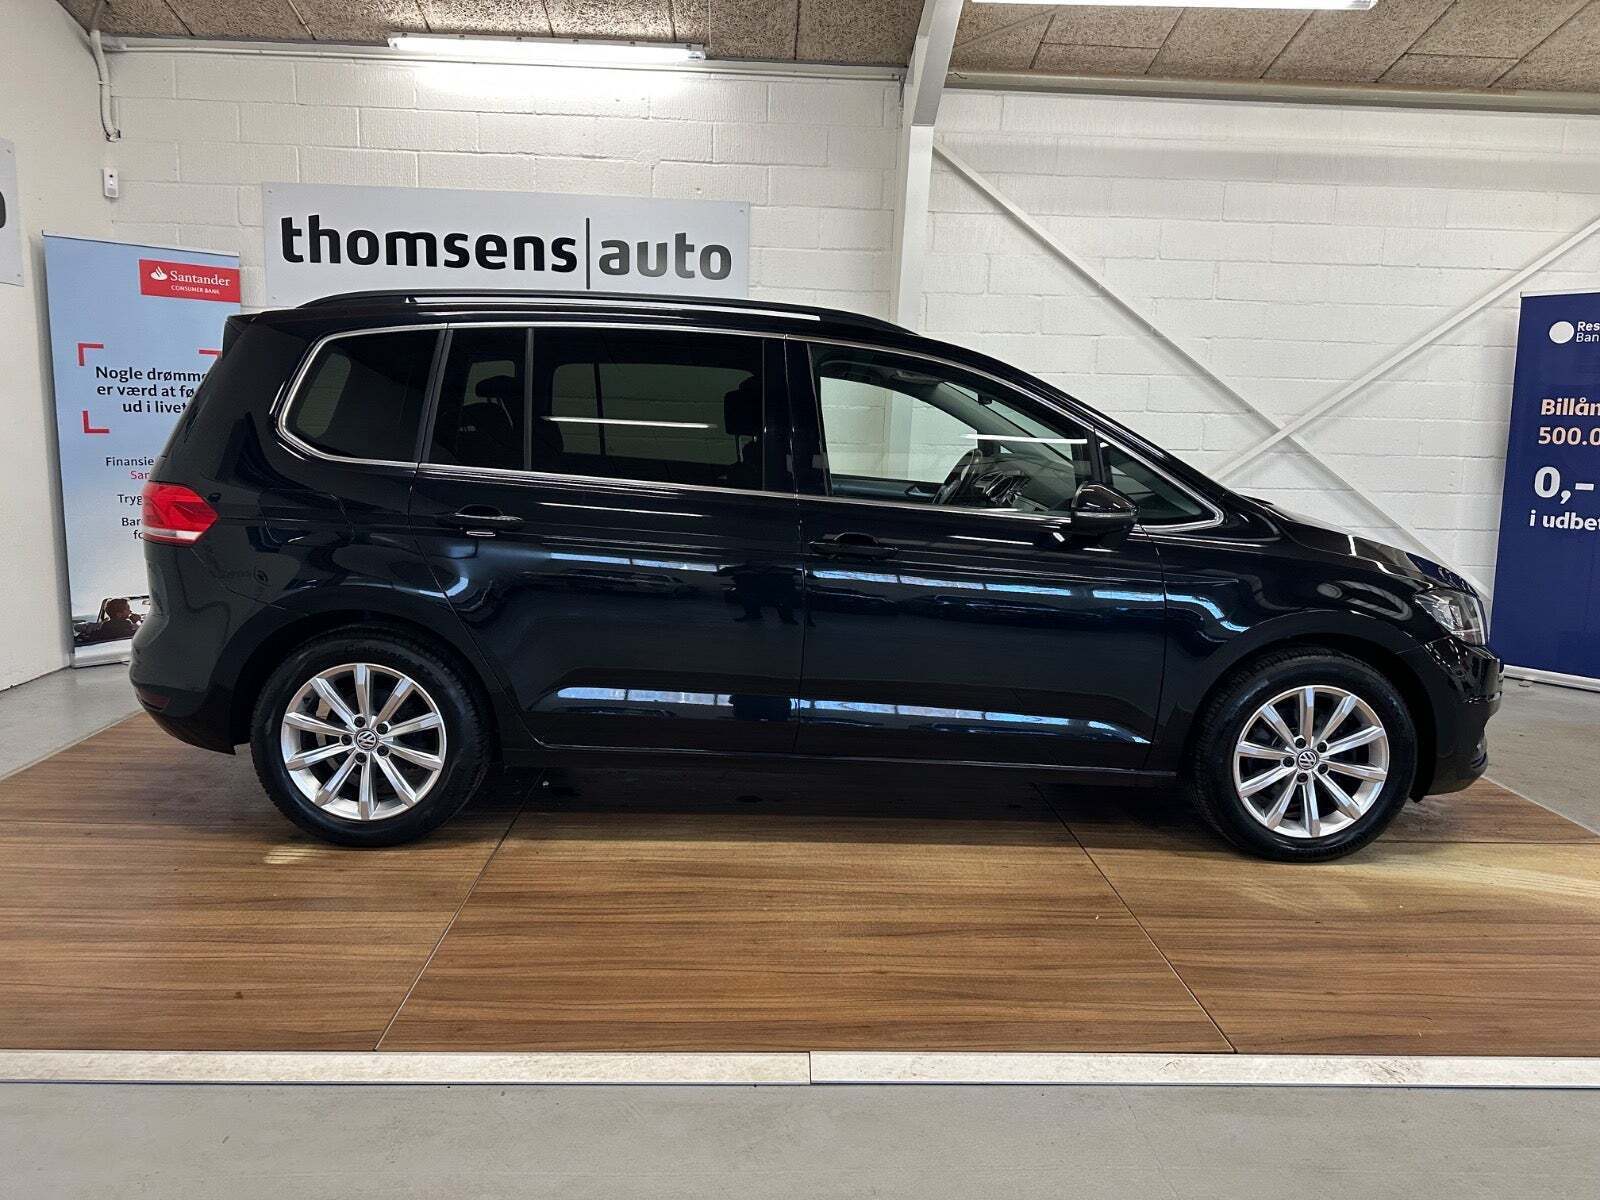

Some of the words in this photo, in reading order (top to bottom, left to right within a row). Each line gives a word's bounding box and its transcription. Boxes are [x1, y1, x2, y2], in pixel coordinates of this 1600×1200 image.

[281, 214, 577, 273] thomsens
[600, 232, 732, 280] auto
[170, 270, 231, 287] Santander
[170, 285, 204, 293] CONSUMER
[204, 287, 220, 295] BANK
[95, 366, 143, 383] Nogle
[97, 385, 113, 396] er
[117, 384, 157, 397] værd
[161, 386, 176, 397] at
[122, 400, 142, 413] ud
[147, 400, 151, 413] i
[1541, 397, 1600, 416] Billån
[1529, 509, 1537, 527] i
[1542, 512, 1600, 531] udbe
